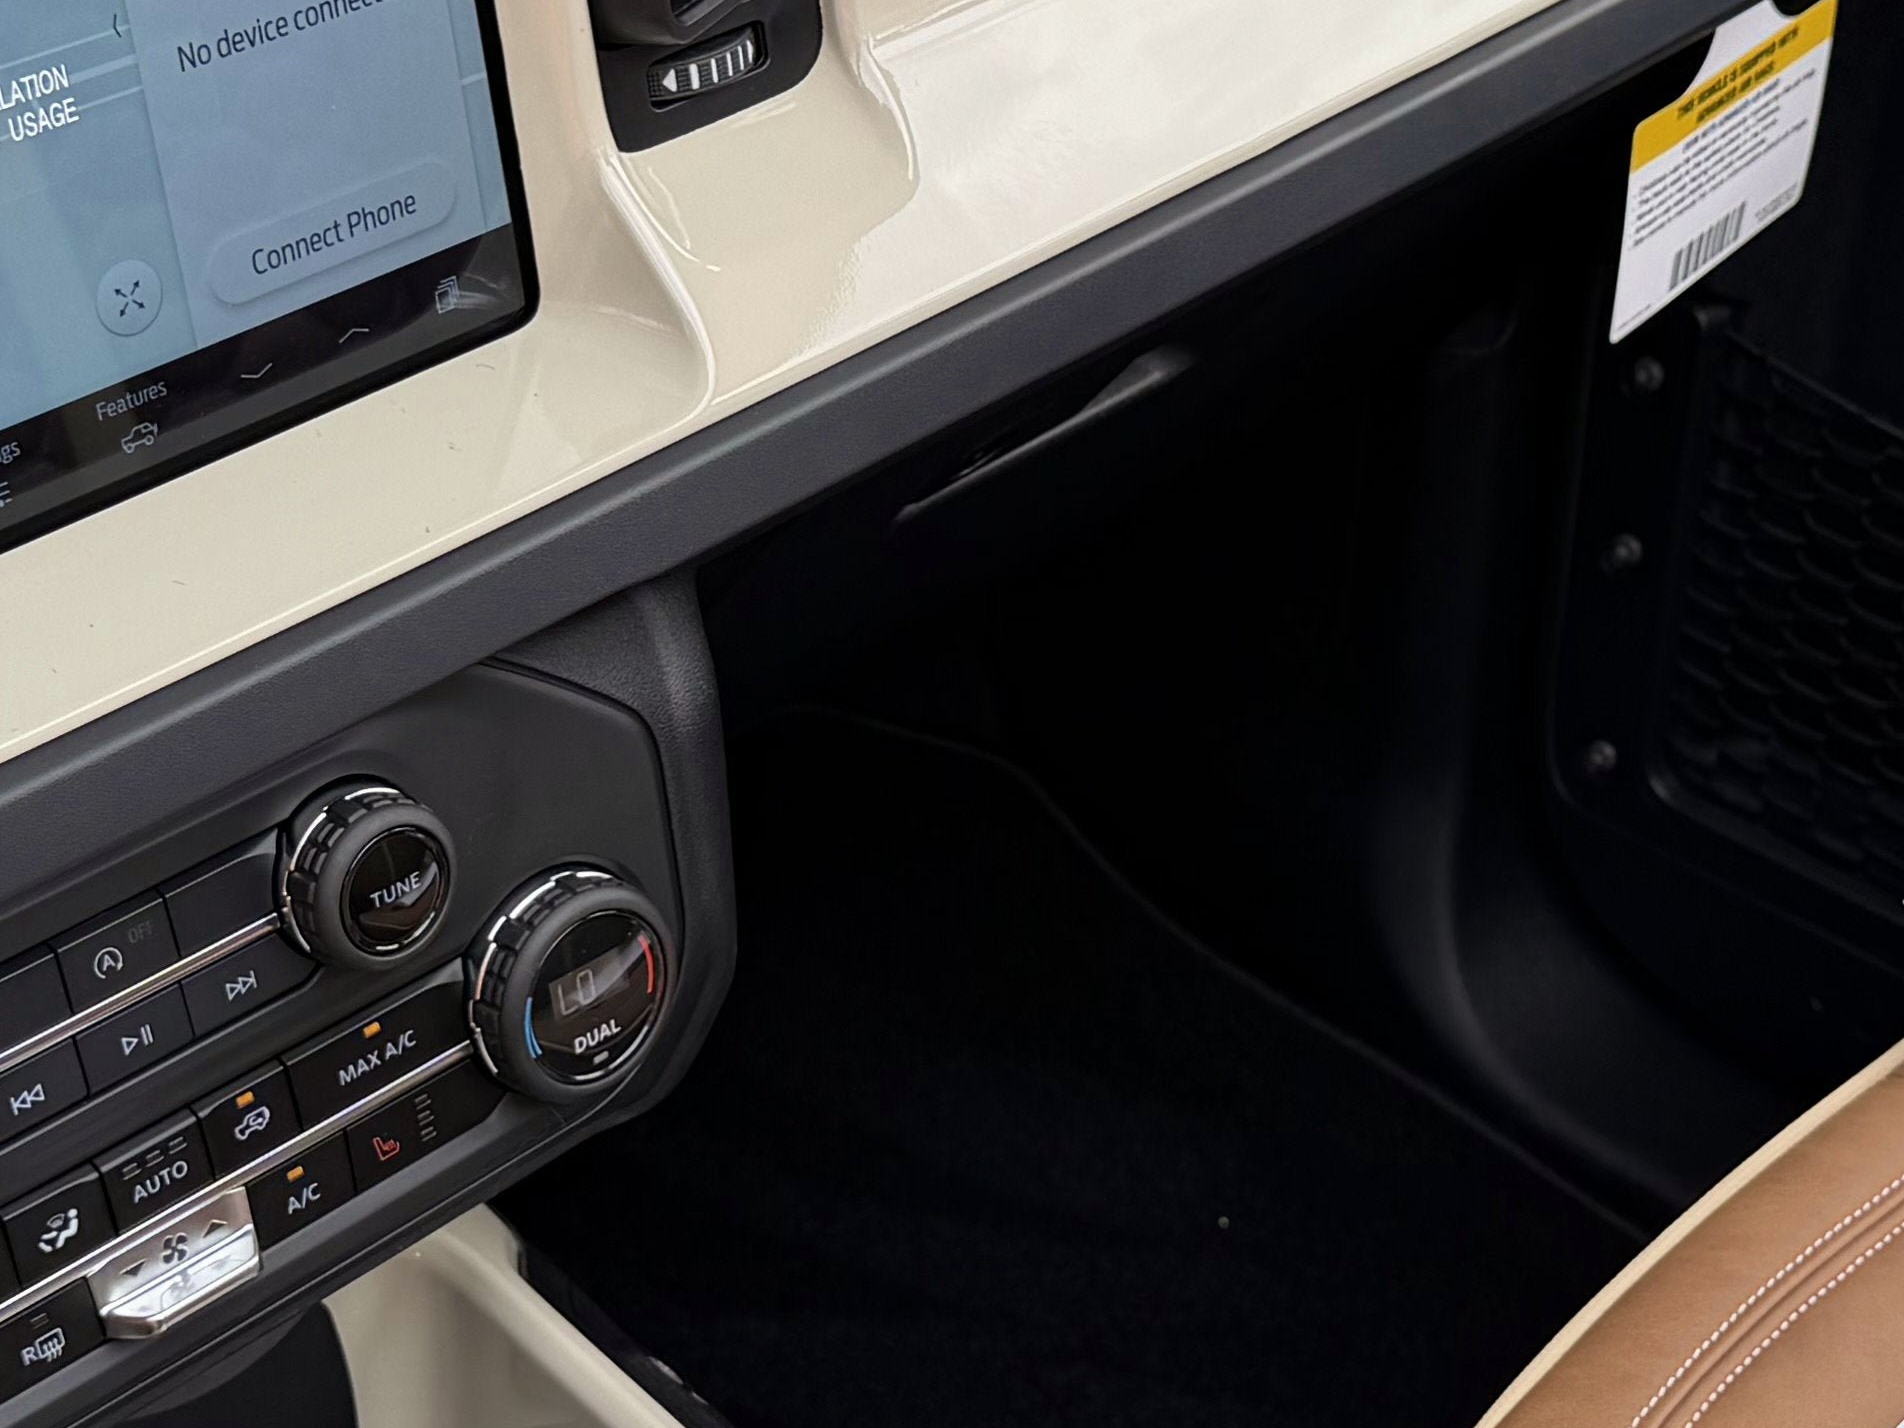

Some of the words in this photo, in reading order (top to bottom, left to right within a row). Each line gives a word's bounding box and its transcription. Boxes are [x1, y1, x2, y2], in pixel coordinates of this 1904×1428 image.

[177, 42, 213, 72] No
[217, 13, 289, 59] device
[8, 98, 80, 141] USAGE
[252, 219, 344, 275] Connect
[347, 193, 417, 239] Phone
[95, 379, 169, 421] Features
[370, 871, 421, 909] TUNE
[338, 1050, 382, 1086] MAX
[384, 1029, 417, 1063] A/C
[573, 1019, 622, 1056] DUAL
[132, 1160, 189, 1205] AUTO
[286, 1183, 322, 1215] A/C
[20, 1348, 40, 1366] R
